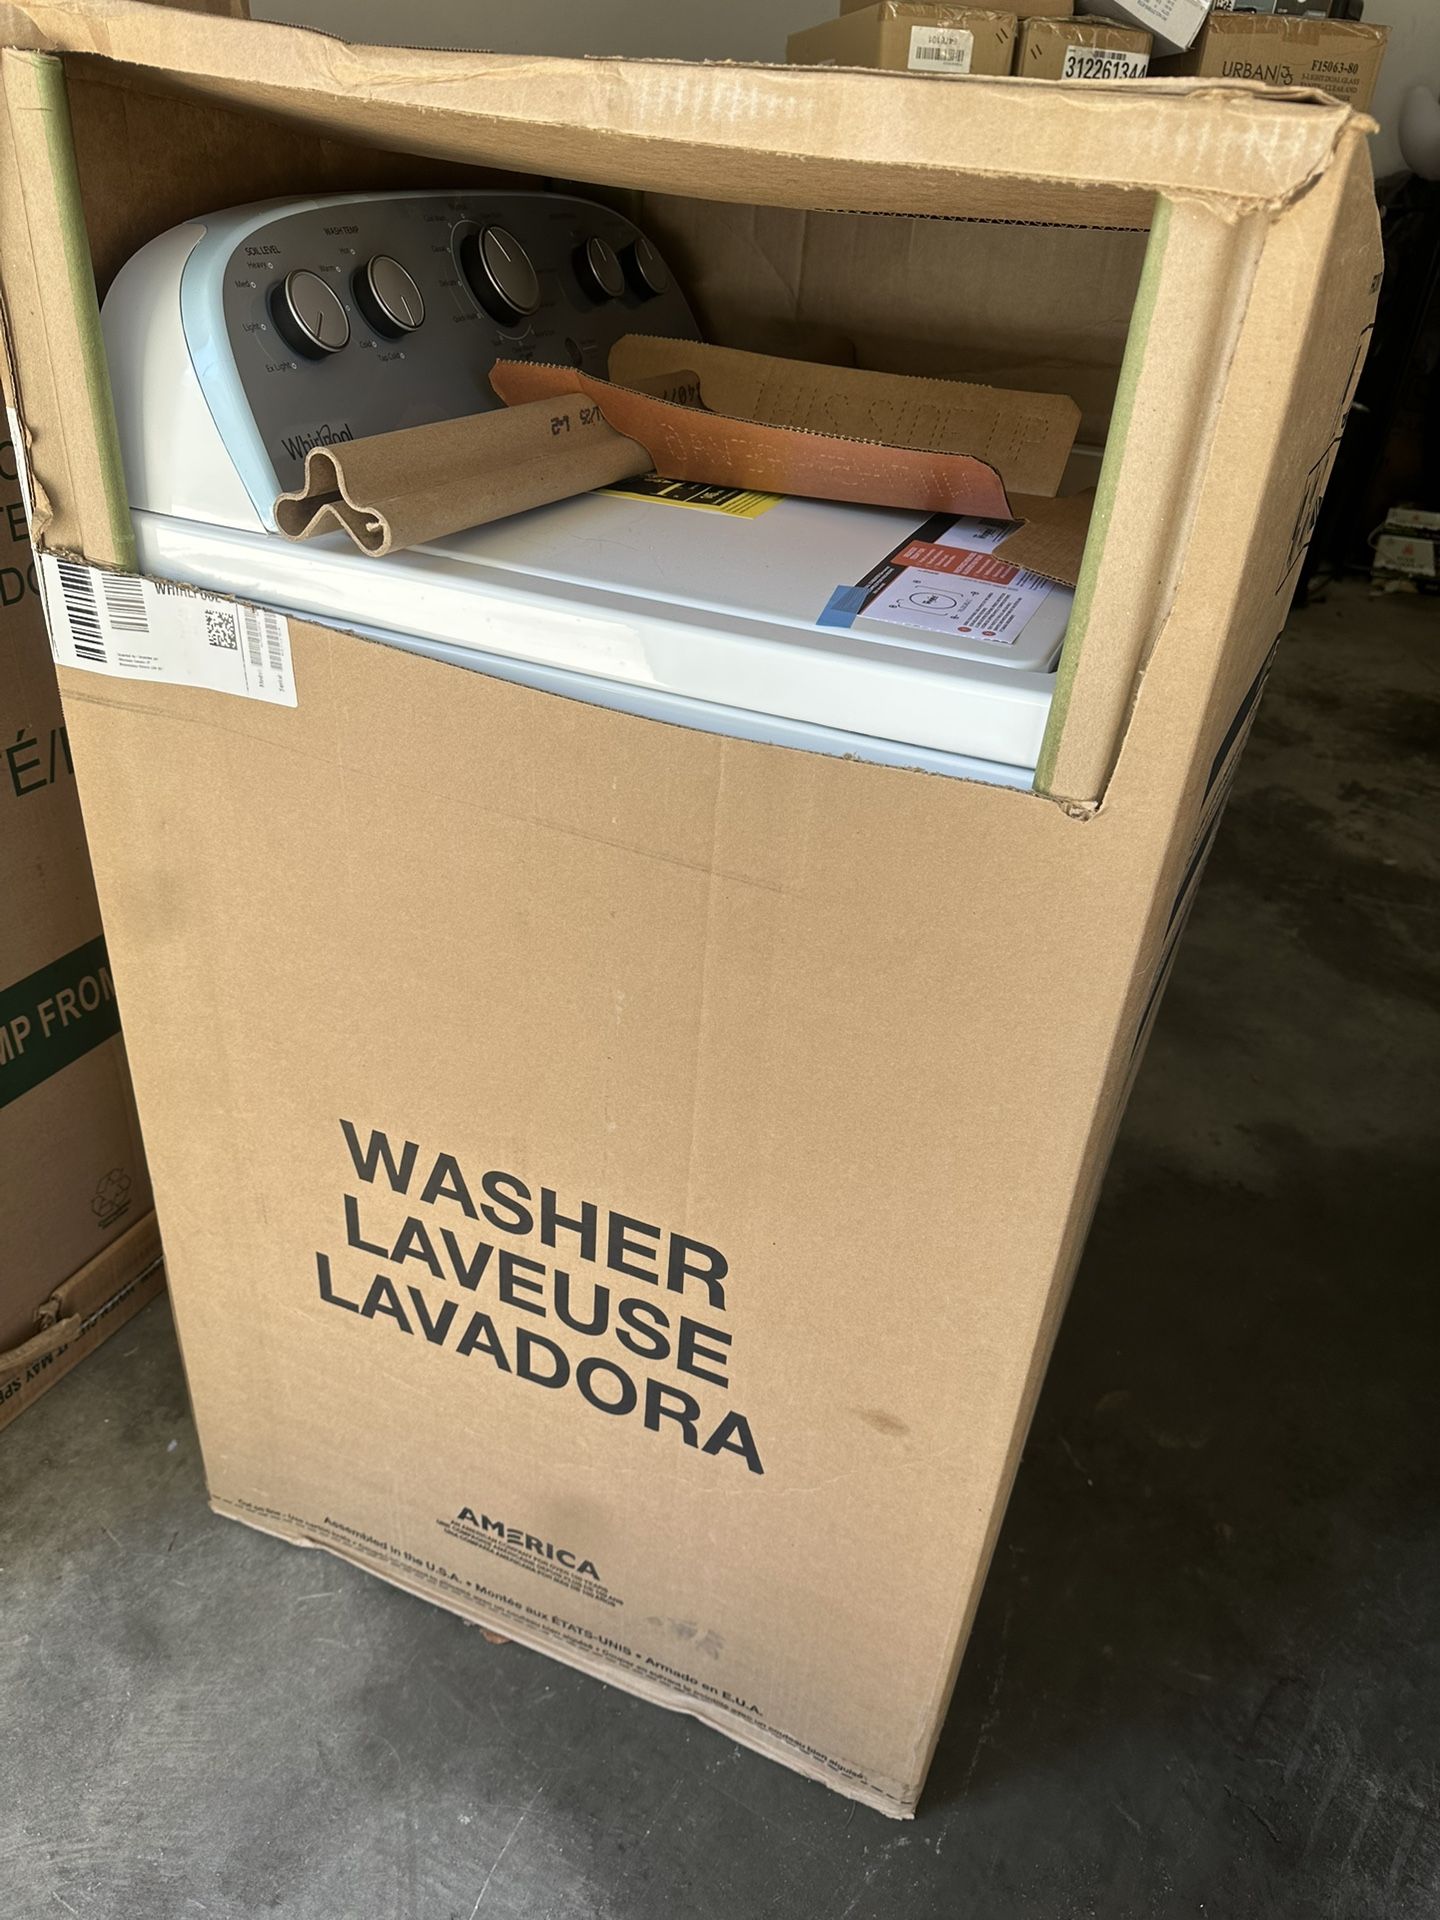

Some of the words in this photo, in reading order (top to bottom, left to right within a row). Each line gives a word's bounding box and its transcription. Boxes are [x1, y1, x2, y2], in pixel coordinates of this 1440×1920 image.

[1311, 59, 1359, 75] F15063-80
[245, 246, 261, 257] SOIL
[262, 244, 281, 254] LEVEL
[339, 1118, 730, 1312] WASHER
[343, 1193, 733, 1389] LAVEUSE
[315, 1251, 765, 1475] LAVADORA
[324, 1516, 388, 1550] Assembled
[390, 1545, 401, 1557] in
[403, 1551, 423, 1566] the
[526, 1606, 549, 1622] aux
[645, 1656, 698, 1686] Armado
[701, 1682, 719, 1695] en
[457, 1506, 600, 1581] AMERICA
